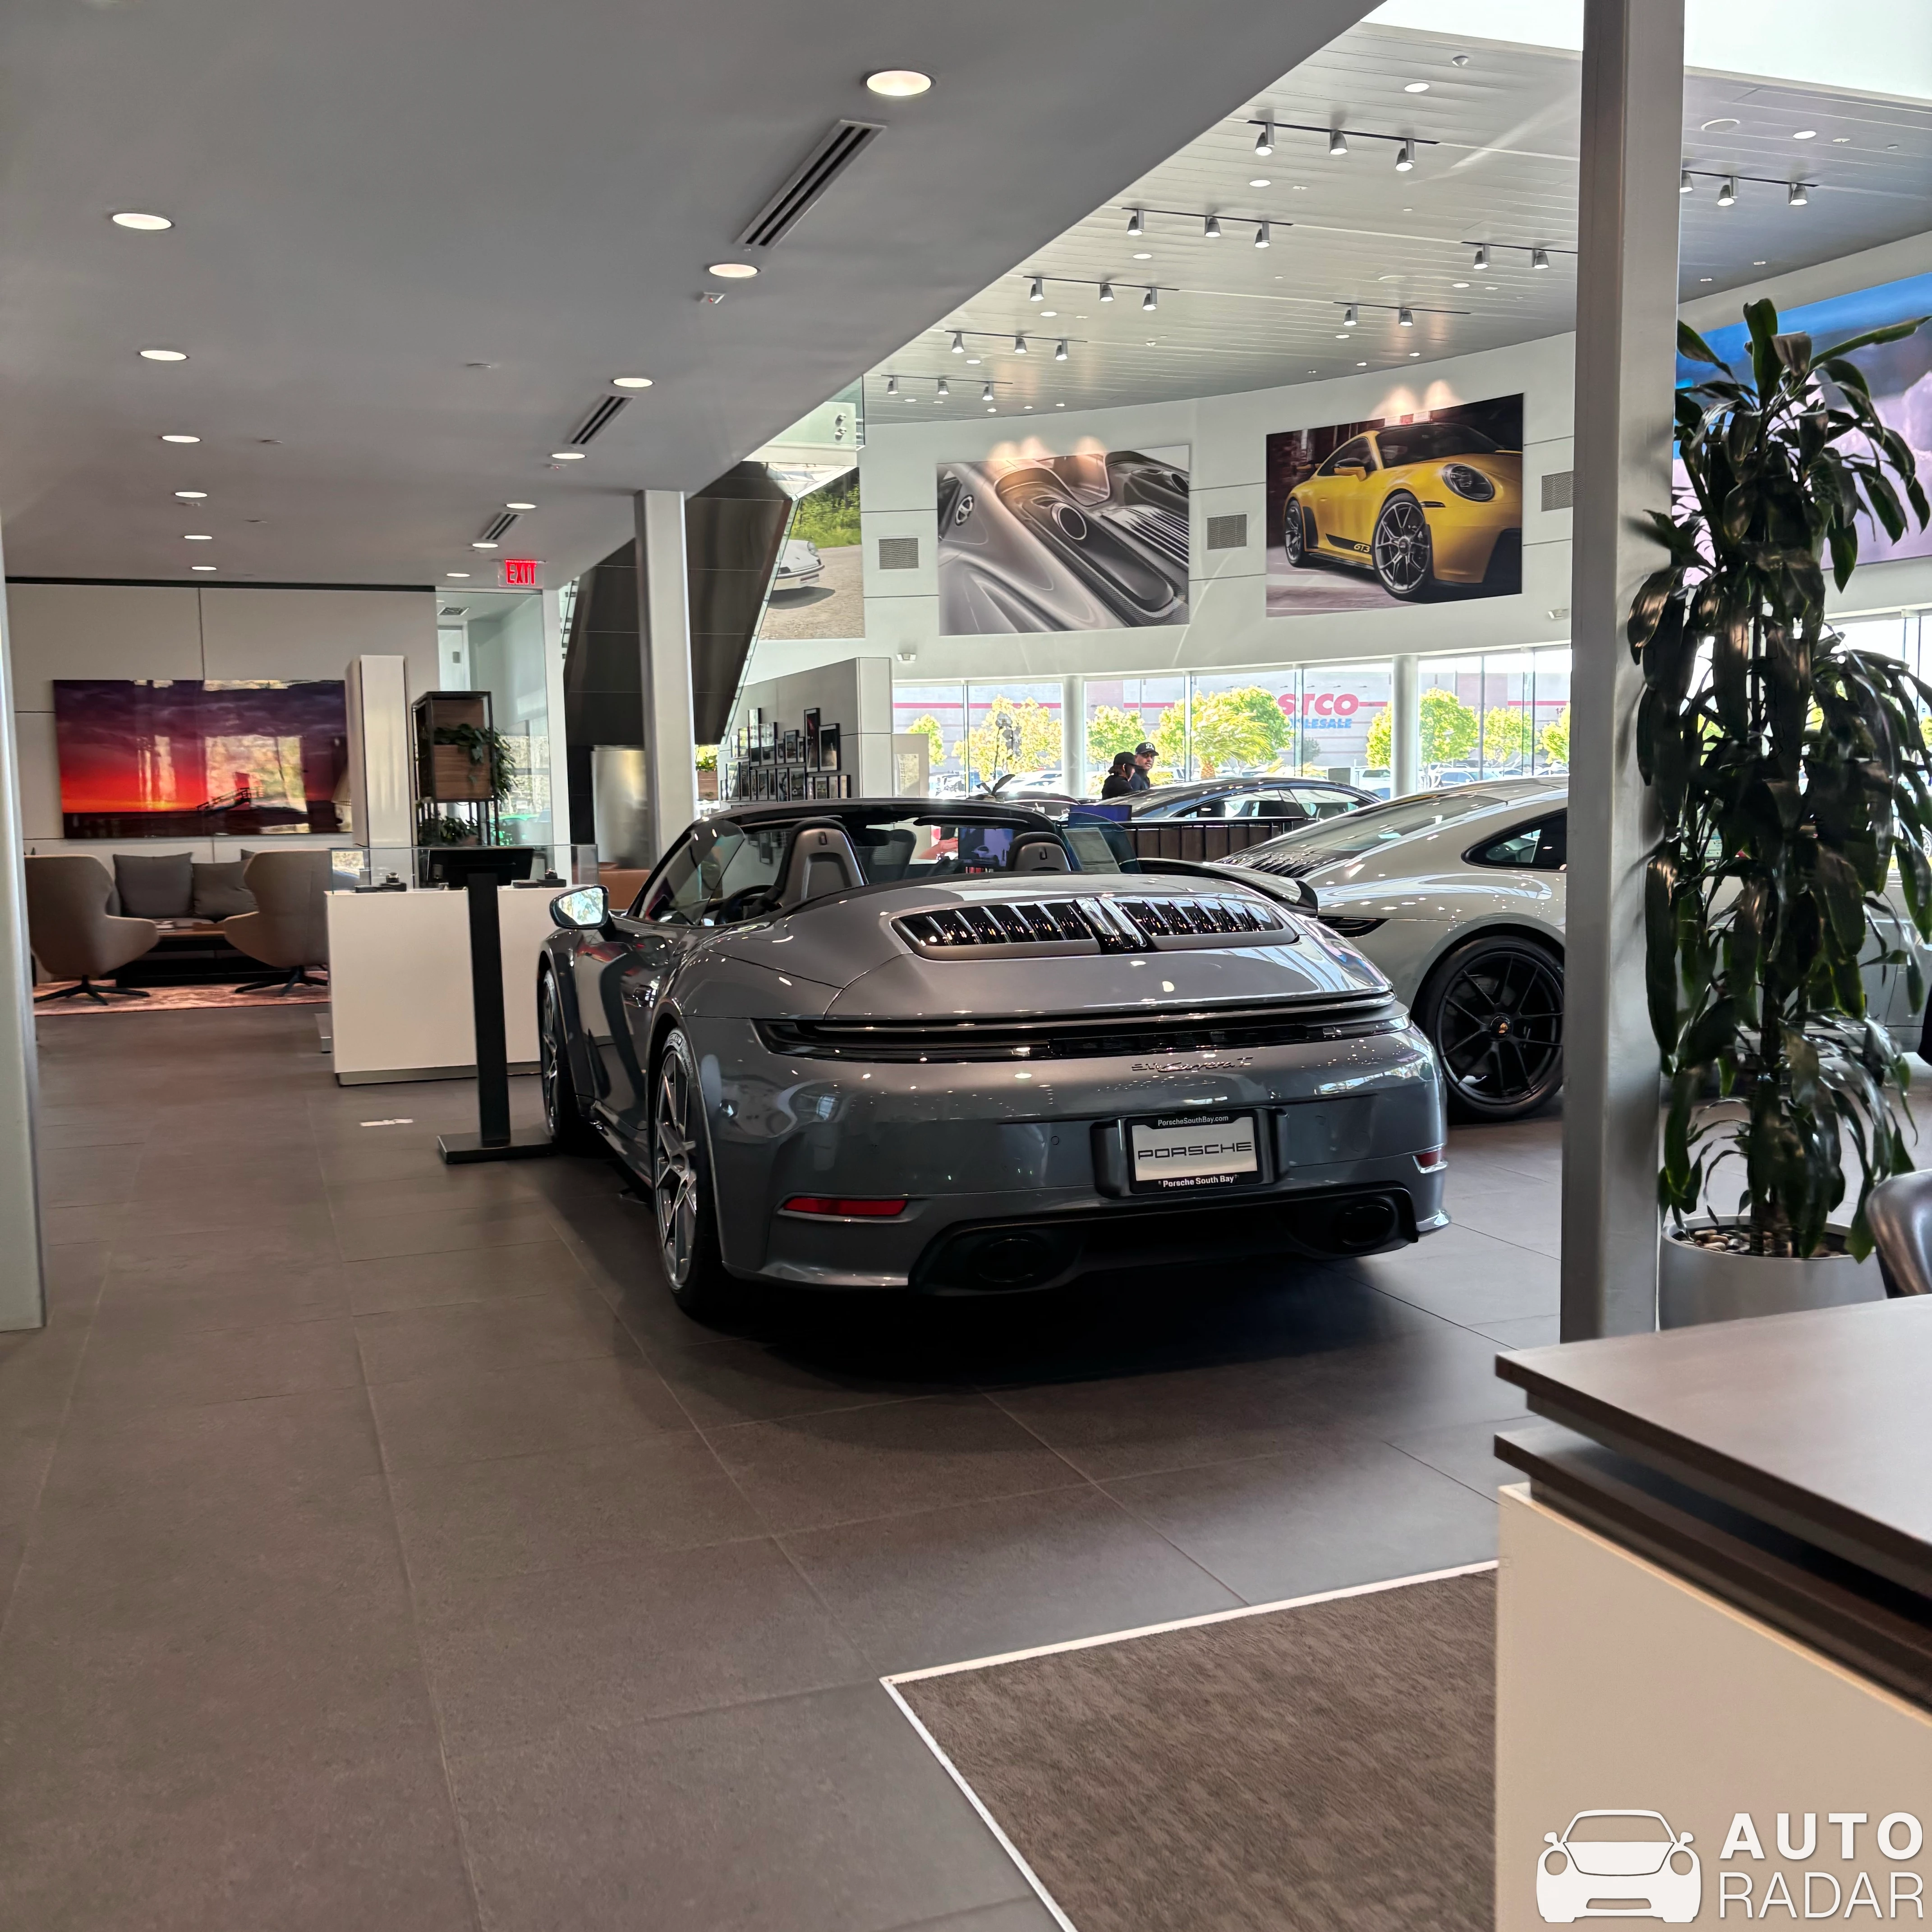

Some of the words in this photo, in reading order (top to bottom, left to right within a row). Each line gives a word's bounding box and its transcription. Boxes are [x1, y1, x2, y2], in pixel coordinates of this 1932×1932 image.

[1353, 543, 1370, 552] GT3
[506, 563, 536, 585] EXIT
[1277, 693, 1359, 716] STCO
[1157, 1116, 1229, 1127] PorscheSouthBay.com
[1138, 1141, 1252, 1160] PORSCHE
[1163, 1178, 1195, 1187] Porsche
[1195, 1176, 1219, 1185] South
[1219, 1174, 1235, 1183] Bay
